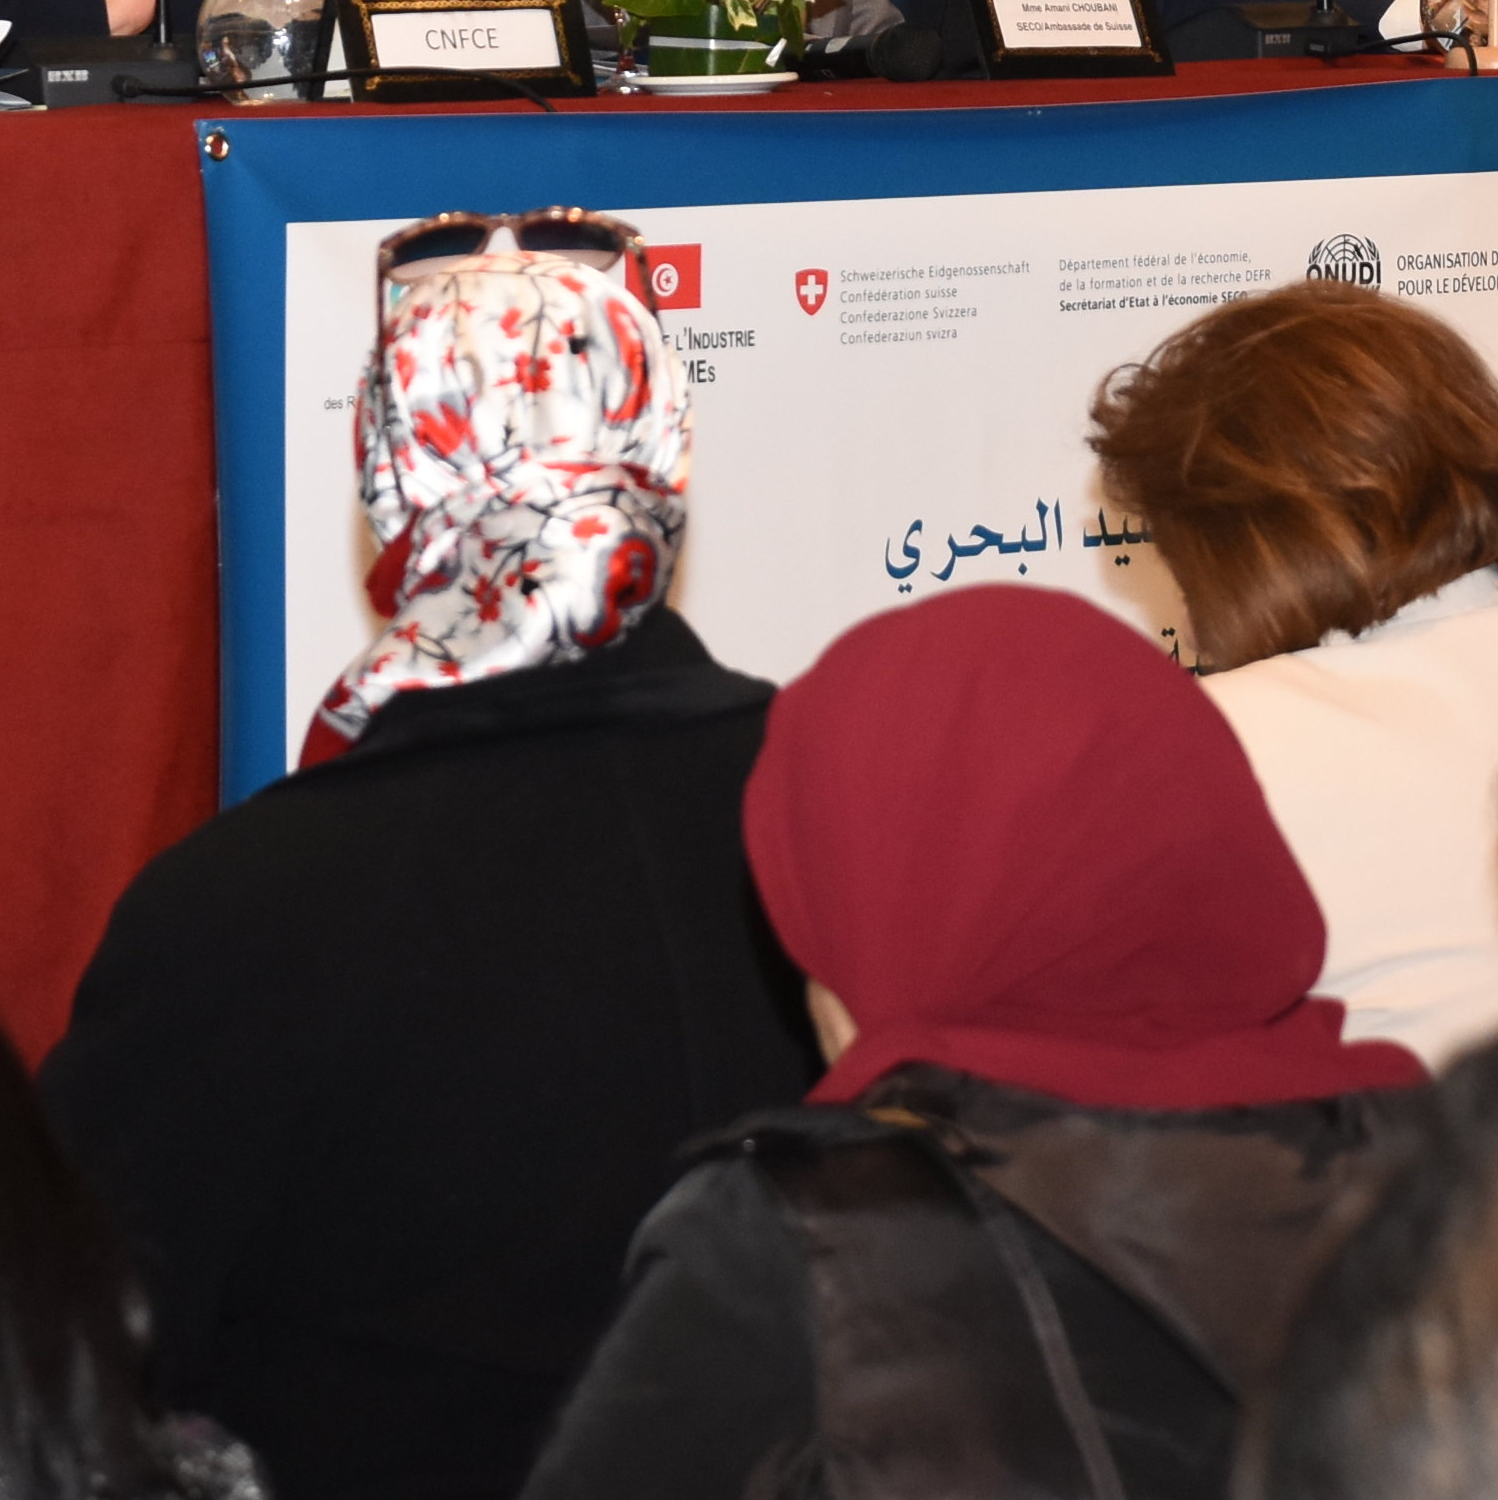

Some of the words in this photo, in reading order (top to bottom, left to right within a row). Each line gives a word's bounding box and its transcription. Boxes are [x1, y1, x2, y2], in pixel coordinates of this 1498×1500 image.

[1021, 3, 1043, 13] Mme
[1044, 2, 1071, 13] Amani
[1093, 22, 1104, 31] de
[1105, 21, 1133, 32] Suisse
[424, 27, 500, 51] CNFCE
[840, 266, 925, 283] Schweizerische
[928, 260, 1031, 281] Eidgenossenschaft
[1059, 253, 1129, 274] Département
[1133, 252, 1171, 269] fédéral
[1174, 252, 1187, 266] de
[1397, 251, 1488, 271] ORGANISATION
[1059, 278, 1073, 292] de
[1075, 277, 1085, 291] la
[1089, 274, 1142, 292] formation
[1146, 275, 1157, 288] et
[1160, 273, 1173, 287] de
[1177, 272, 1187, 286] la
[1190, 269, 1242, 285] recherche
[1245, 268, 1272, 282] DEFR
[1306, 260, 1382, 288] ONUDI
[840, 287, 922, 304] Confédération
[925, 287, 958, 300] suisse
[1397, 279, 1433, 297] POUR
[1436, 278, 1450, 295] LE
[1059, 295, 1116, 313] Secrétariat
[1152, 292, 1160, 307] à
[840, 307, 929, 325] Confederazione
[932, 304, 978, 320] Svizzera
[840, 329, 923, 345] Confederaziun
[926, 327, 958, 342] svizra
[324, 395, 344, 410] des
[885, 496, 1064, 594] البحري
